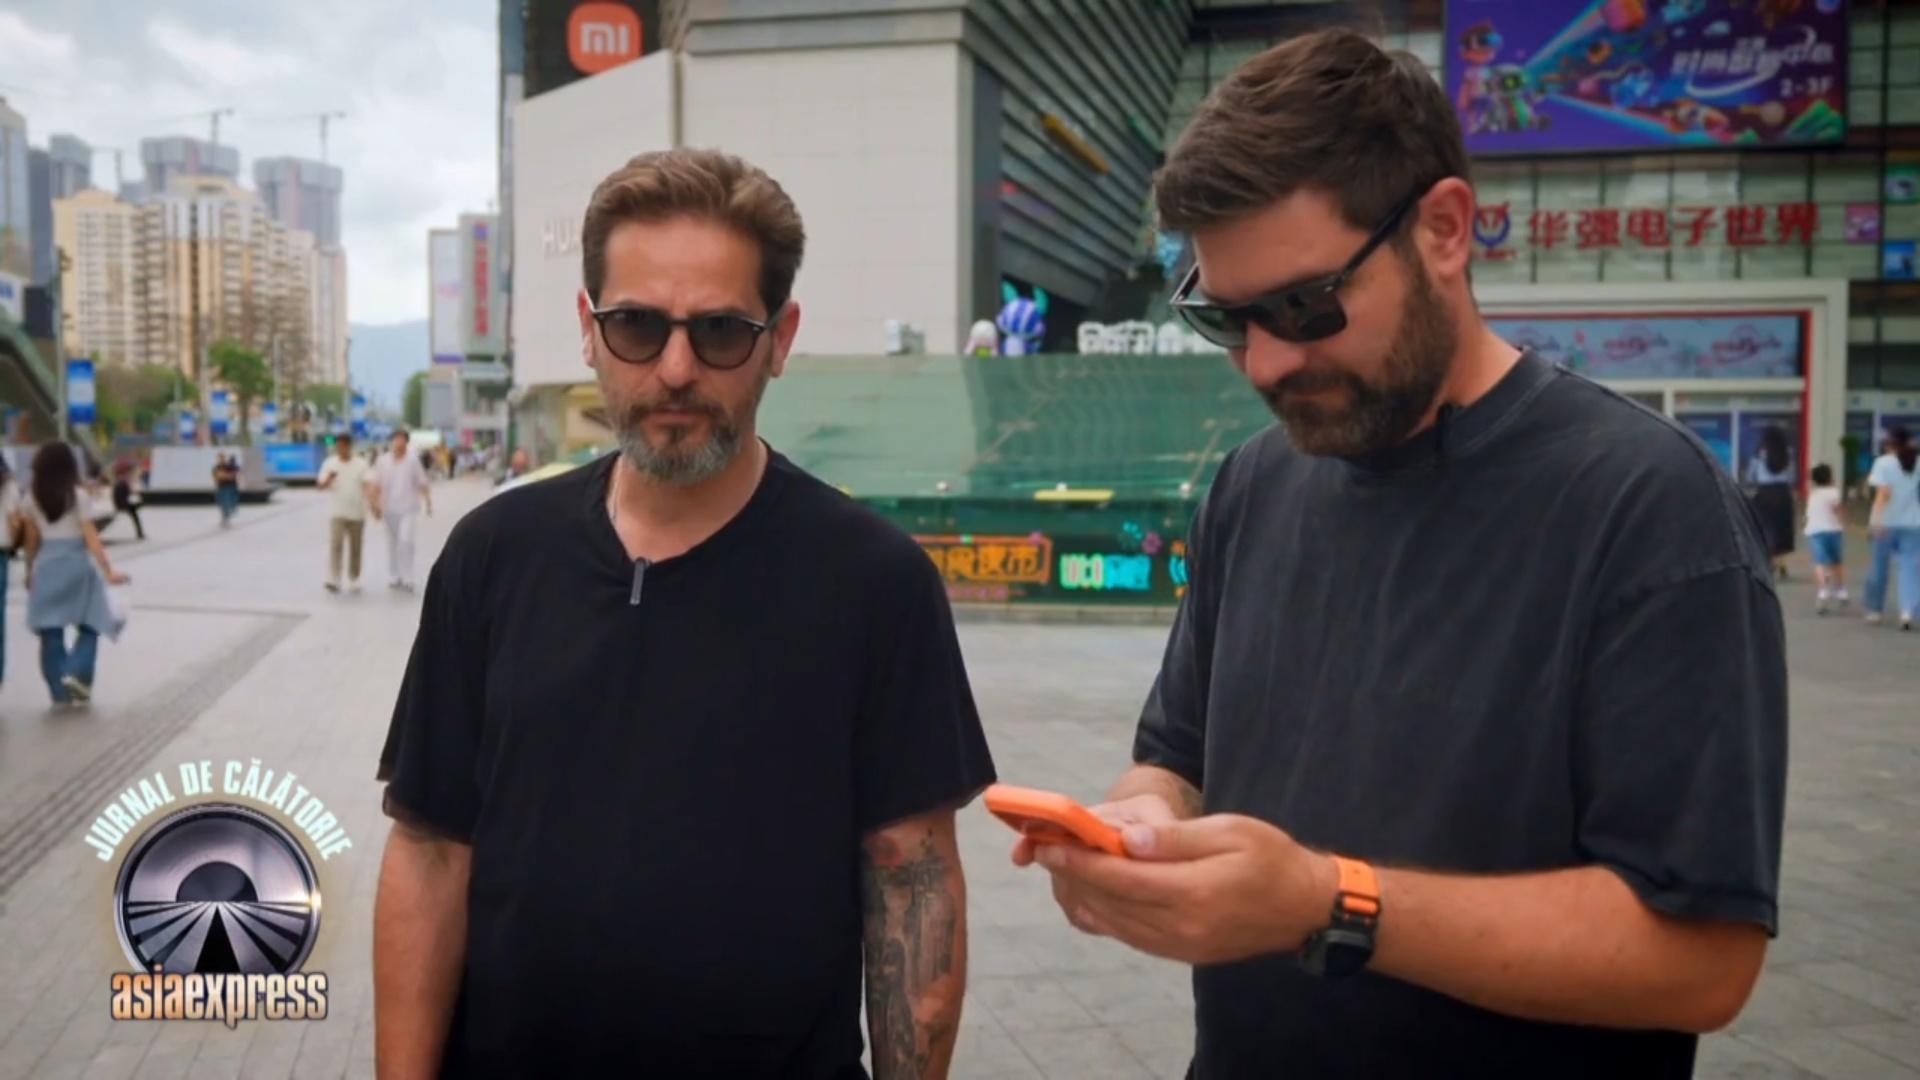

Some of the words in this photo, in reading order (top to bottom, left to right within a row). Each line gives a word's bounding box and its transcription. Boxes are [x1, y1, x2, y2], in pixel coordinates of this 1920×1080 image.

[1528, 203, 1818, 248] 华强电子世界
